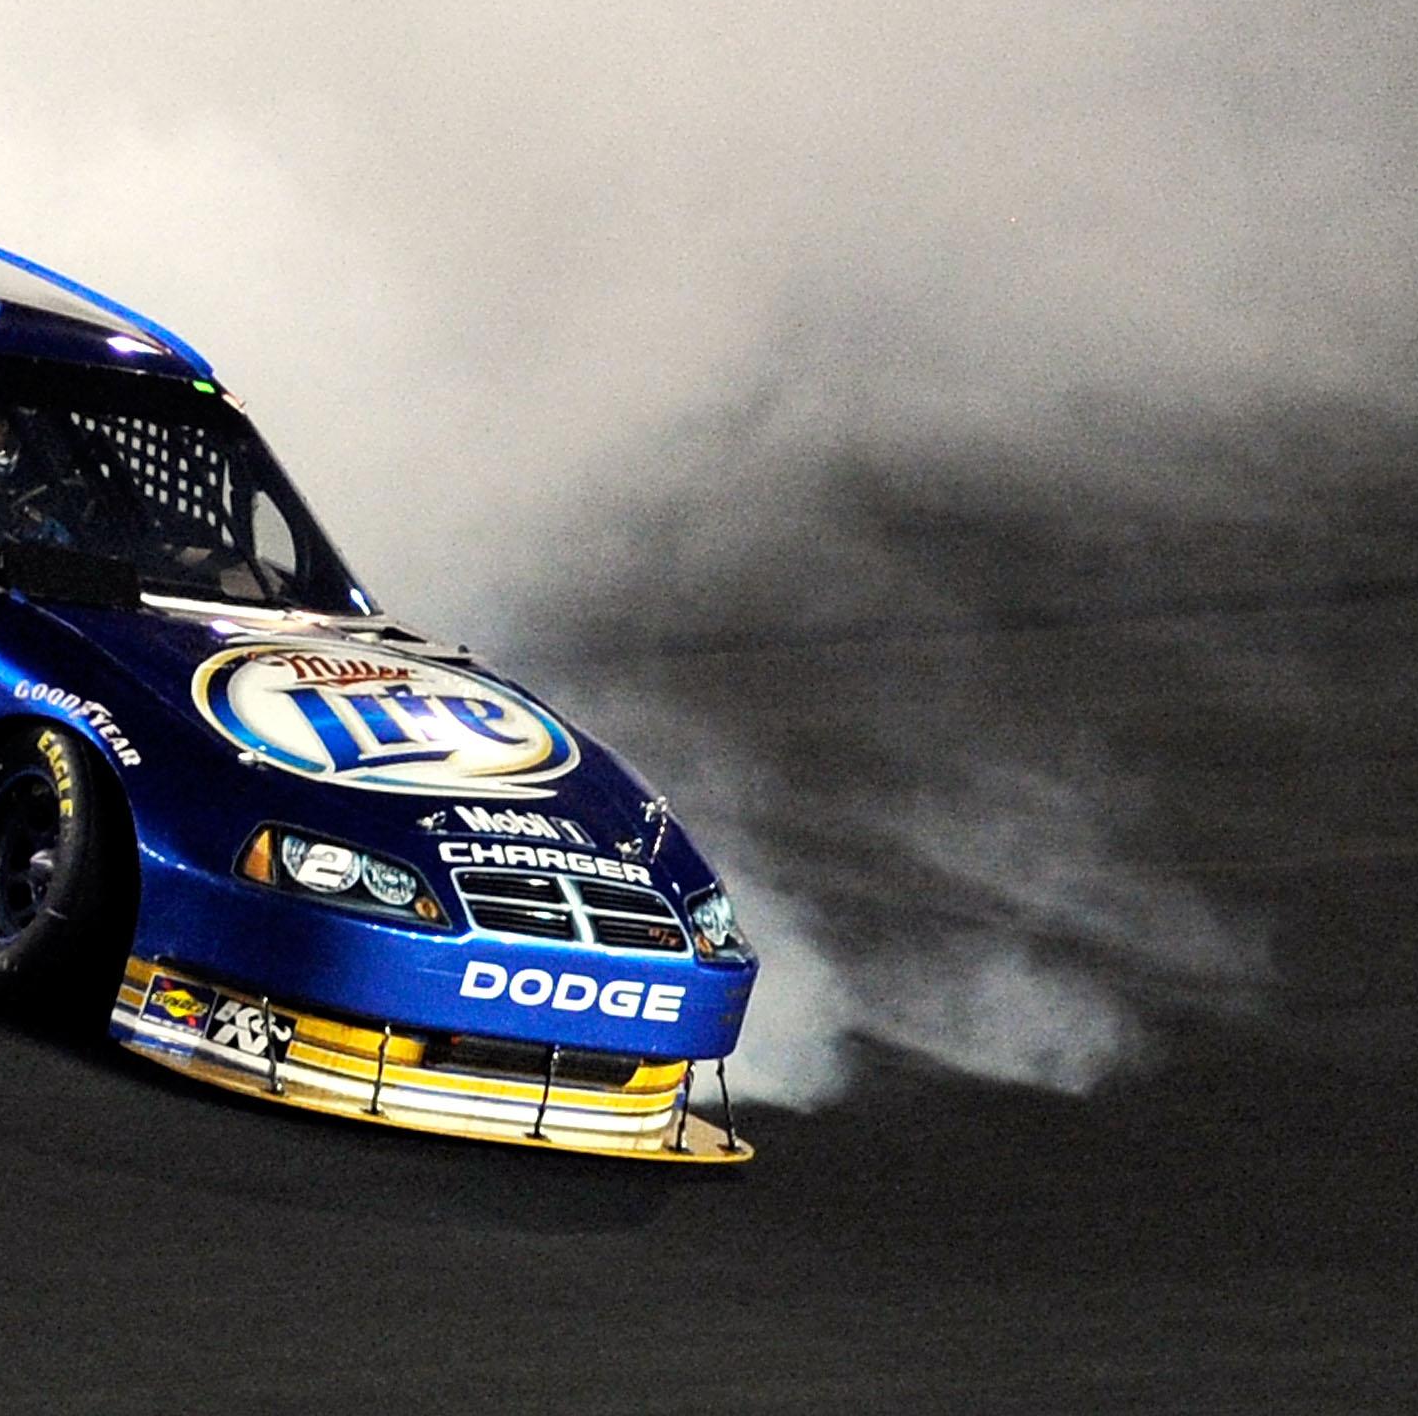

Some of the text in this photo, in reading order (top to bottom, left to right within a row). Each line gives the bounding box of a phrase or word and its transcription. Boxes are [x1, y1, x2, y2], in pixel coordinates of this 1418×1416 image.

[271, 653, 415, 687] Miller
[13, 679, 142, 768] GOODYEAR
[37, 730, 73, 818] EAGLE
[454, 806, 590, 846] Mobil 1
[295, 843, 353, 888] 2
[438, 842, 653, 886] CHARGER
[459, 960, 686, 1022] DODGE
